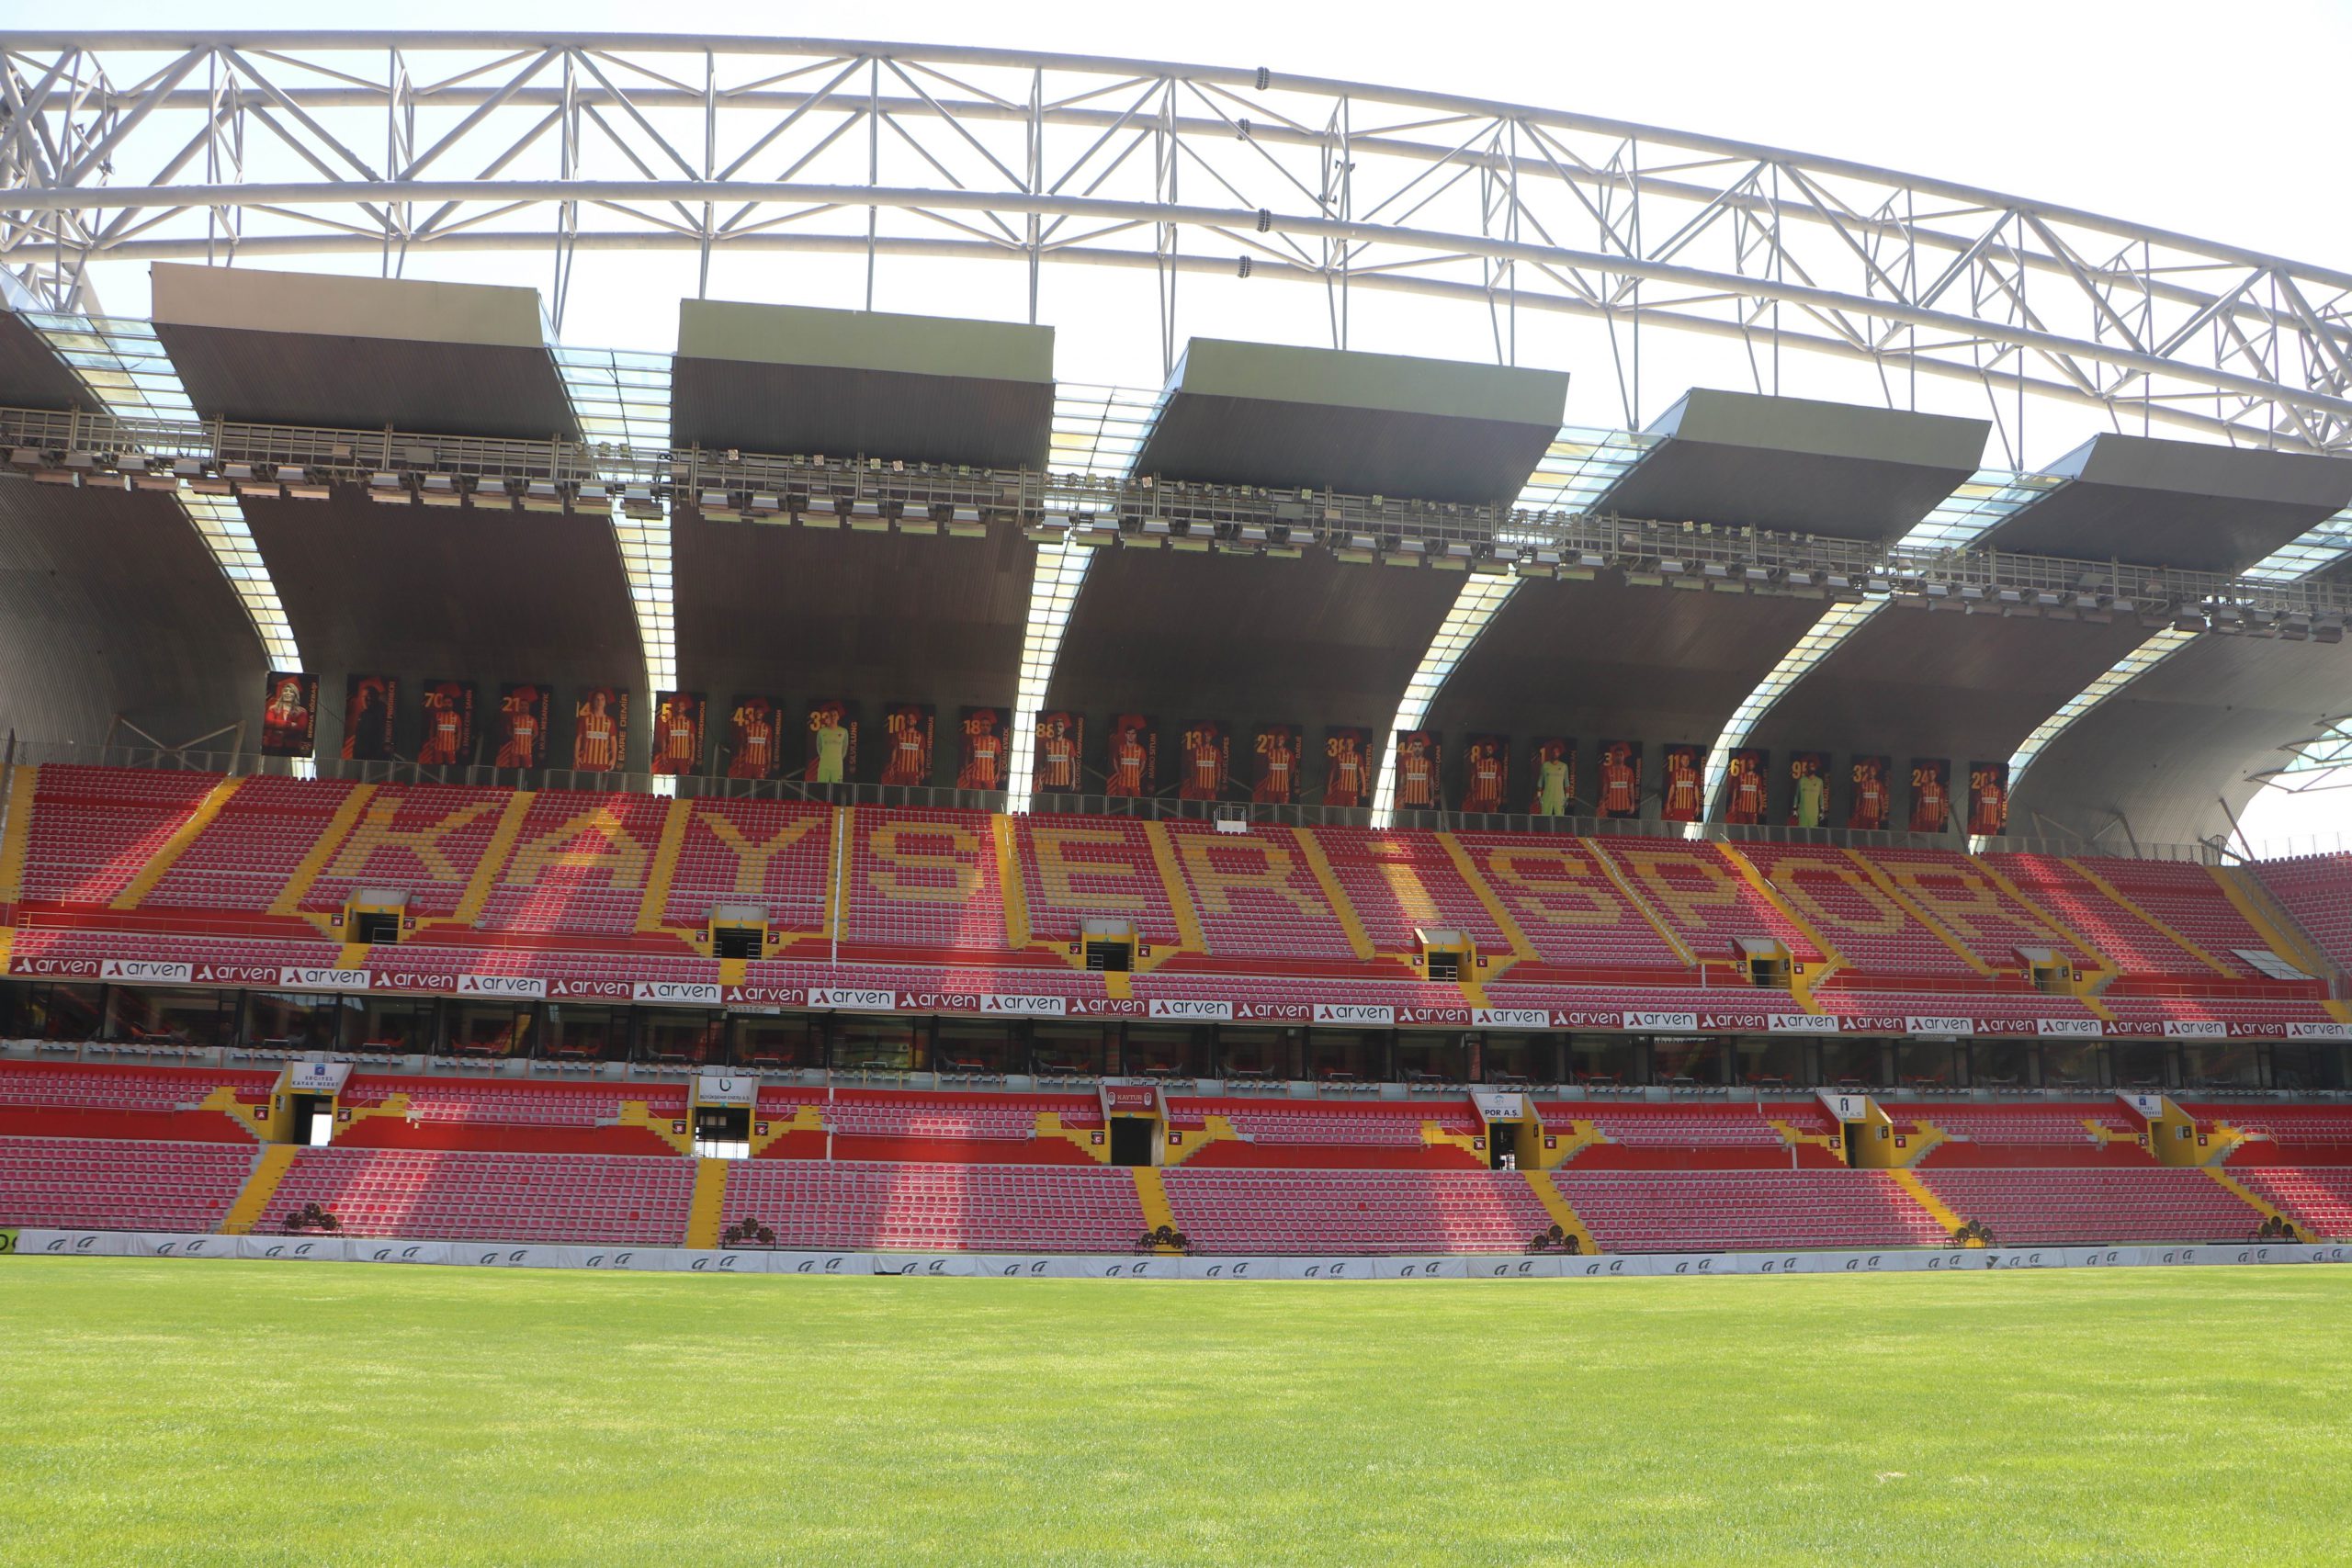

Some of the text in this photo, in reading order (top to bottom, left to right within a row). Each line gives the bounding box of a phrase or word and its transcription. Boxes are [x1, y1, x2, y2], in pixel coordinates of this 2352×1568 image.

[424, 693, 444, 707] 70
[502, 696, 520, 712] 21
[661, 703, 672, 723] 5
[617, 694, 628, 761] EMRE DEMİR
[888, 714, 906, 733] 10
[964, 719, 981, 735] 18
[37, 960, 96, 973] arven
[127, 963, 187, 976] arven
[217, 966, 276, 980] arven
[306, 970, 364, 984] arven
[395, 974, 453, 987] arven
[483, 977, 540, 992] arven
[571, 981, 628, 995] arven
[658, 985, 716, 998] arven
[746, 987, 803, 1001] arven
[832, 991, 889, 1004] arven
[919, 994, 976, 1007] arven
[1004, 997, 1060, 1010] arven
[1090, 999, 1145, 1012] arven
[1172, 1001, 1227, 1015] arven
[1255, 1005, 1308, 1017] arven
[1336, 1007, 1389, 1019] arven
[1416, 1009, 1467, 1021] arven
[1494, 1010, 1544, 1022] arven
[1569, 1012, 1619, 1024] arven
[1645, 1014, 1692, 1025] arven
[1717, 1015, 1764, 1026] arven
[1788, 1016, 1834, 1027] arven
[1858, 1018, 1903, 1028] arven
[1925, 1019, 1969, 1030] arven
[1991, 1021, 2034, 1031] arven
[2056, 1021, 2098, 1032] arven
[2120, 1022, 2161, 1032] arven
[2181, 1022, 2222, 1033] arven
[2243, 1023, 2283, 1033] arven
[2303, 1024, 2344, 1034] arven
